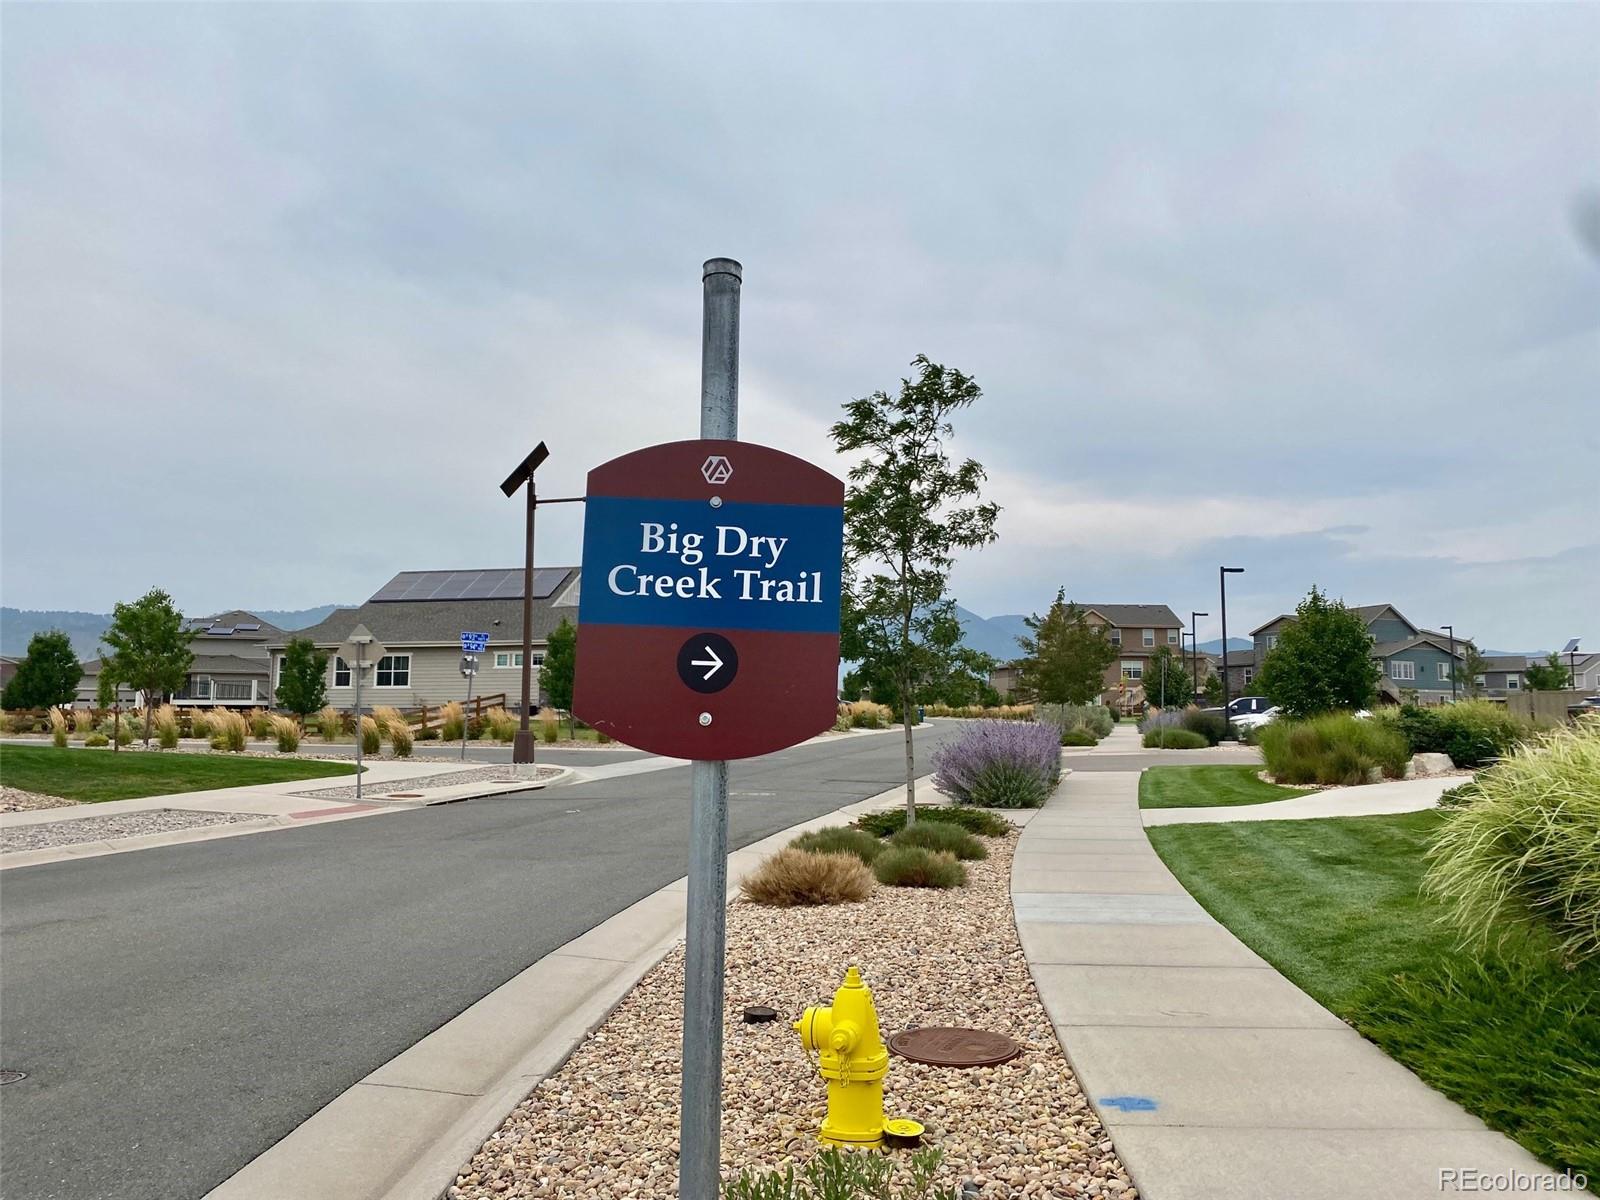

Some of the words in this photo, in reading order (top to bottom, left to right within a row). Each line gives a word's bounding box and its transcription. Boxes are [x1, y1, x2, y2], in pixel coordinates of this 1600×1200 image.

[641, 523, 704, 565] Big
[716, 526, 788, 568] Dry
[608, 564, 722, 599] Creek
[734, 569, 823, 603] Trail
